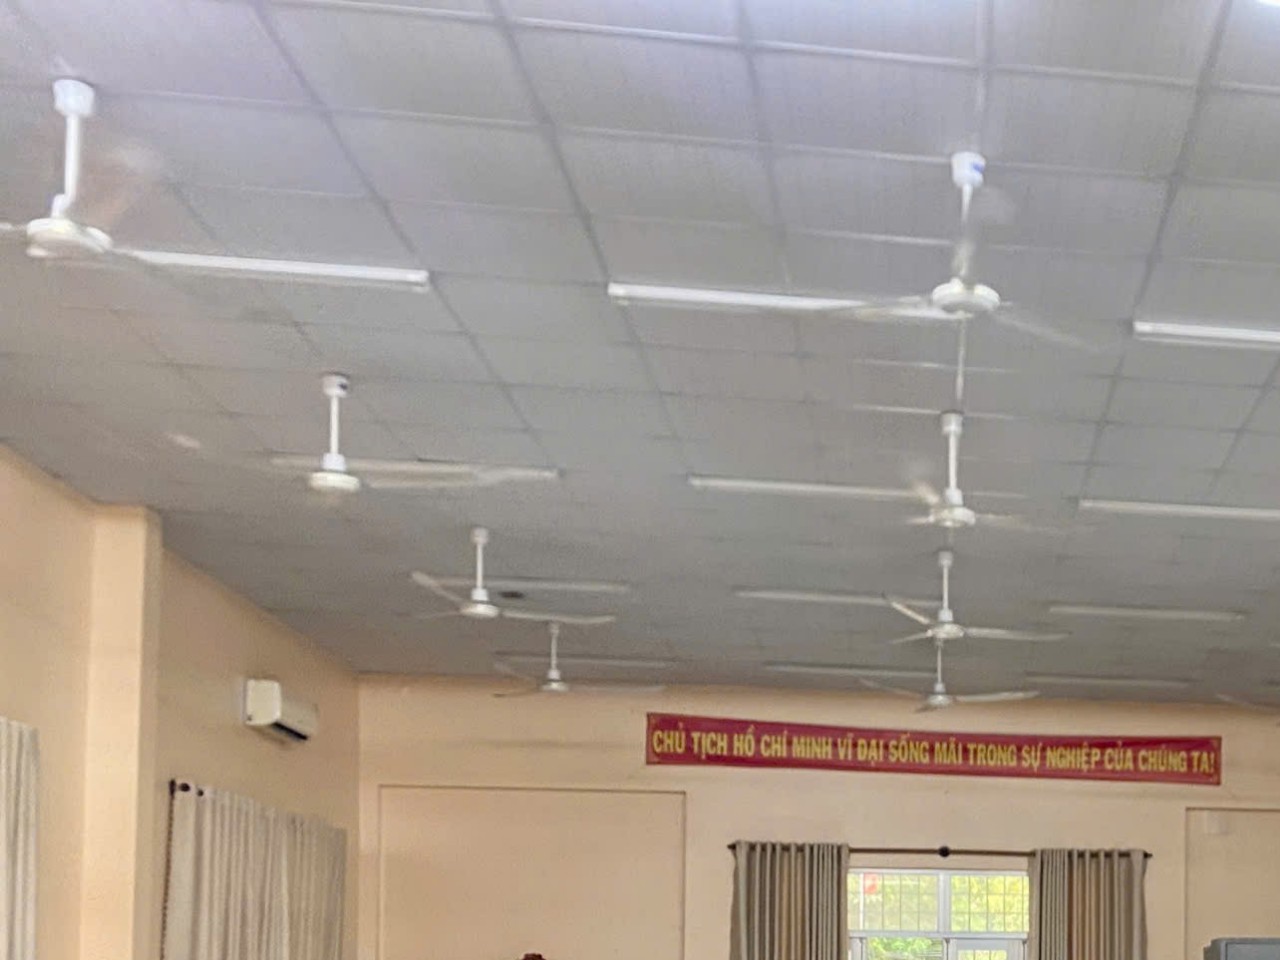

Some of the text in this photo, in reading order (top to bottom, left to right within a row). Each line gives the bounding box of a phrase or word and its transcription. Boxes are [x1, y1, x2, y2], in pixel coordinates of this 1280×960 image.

[691, 731, 728, 760] TỊCH
[760, 729, 788, 758] CHÍ
[792, 735, 832, 760] MINH
[857, 738, 884, 767] ĐẠI
[888, 732, 930, 764] SỐNG
[966, 743, 1018, 767] TRONG
[1046, 741, 1101, 773] NGHIỆP
[1103, 741, 1134, 771] CỦA
[1138, 744, 1188, 772] CHÚNG
